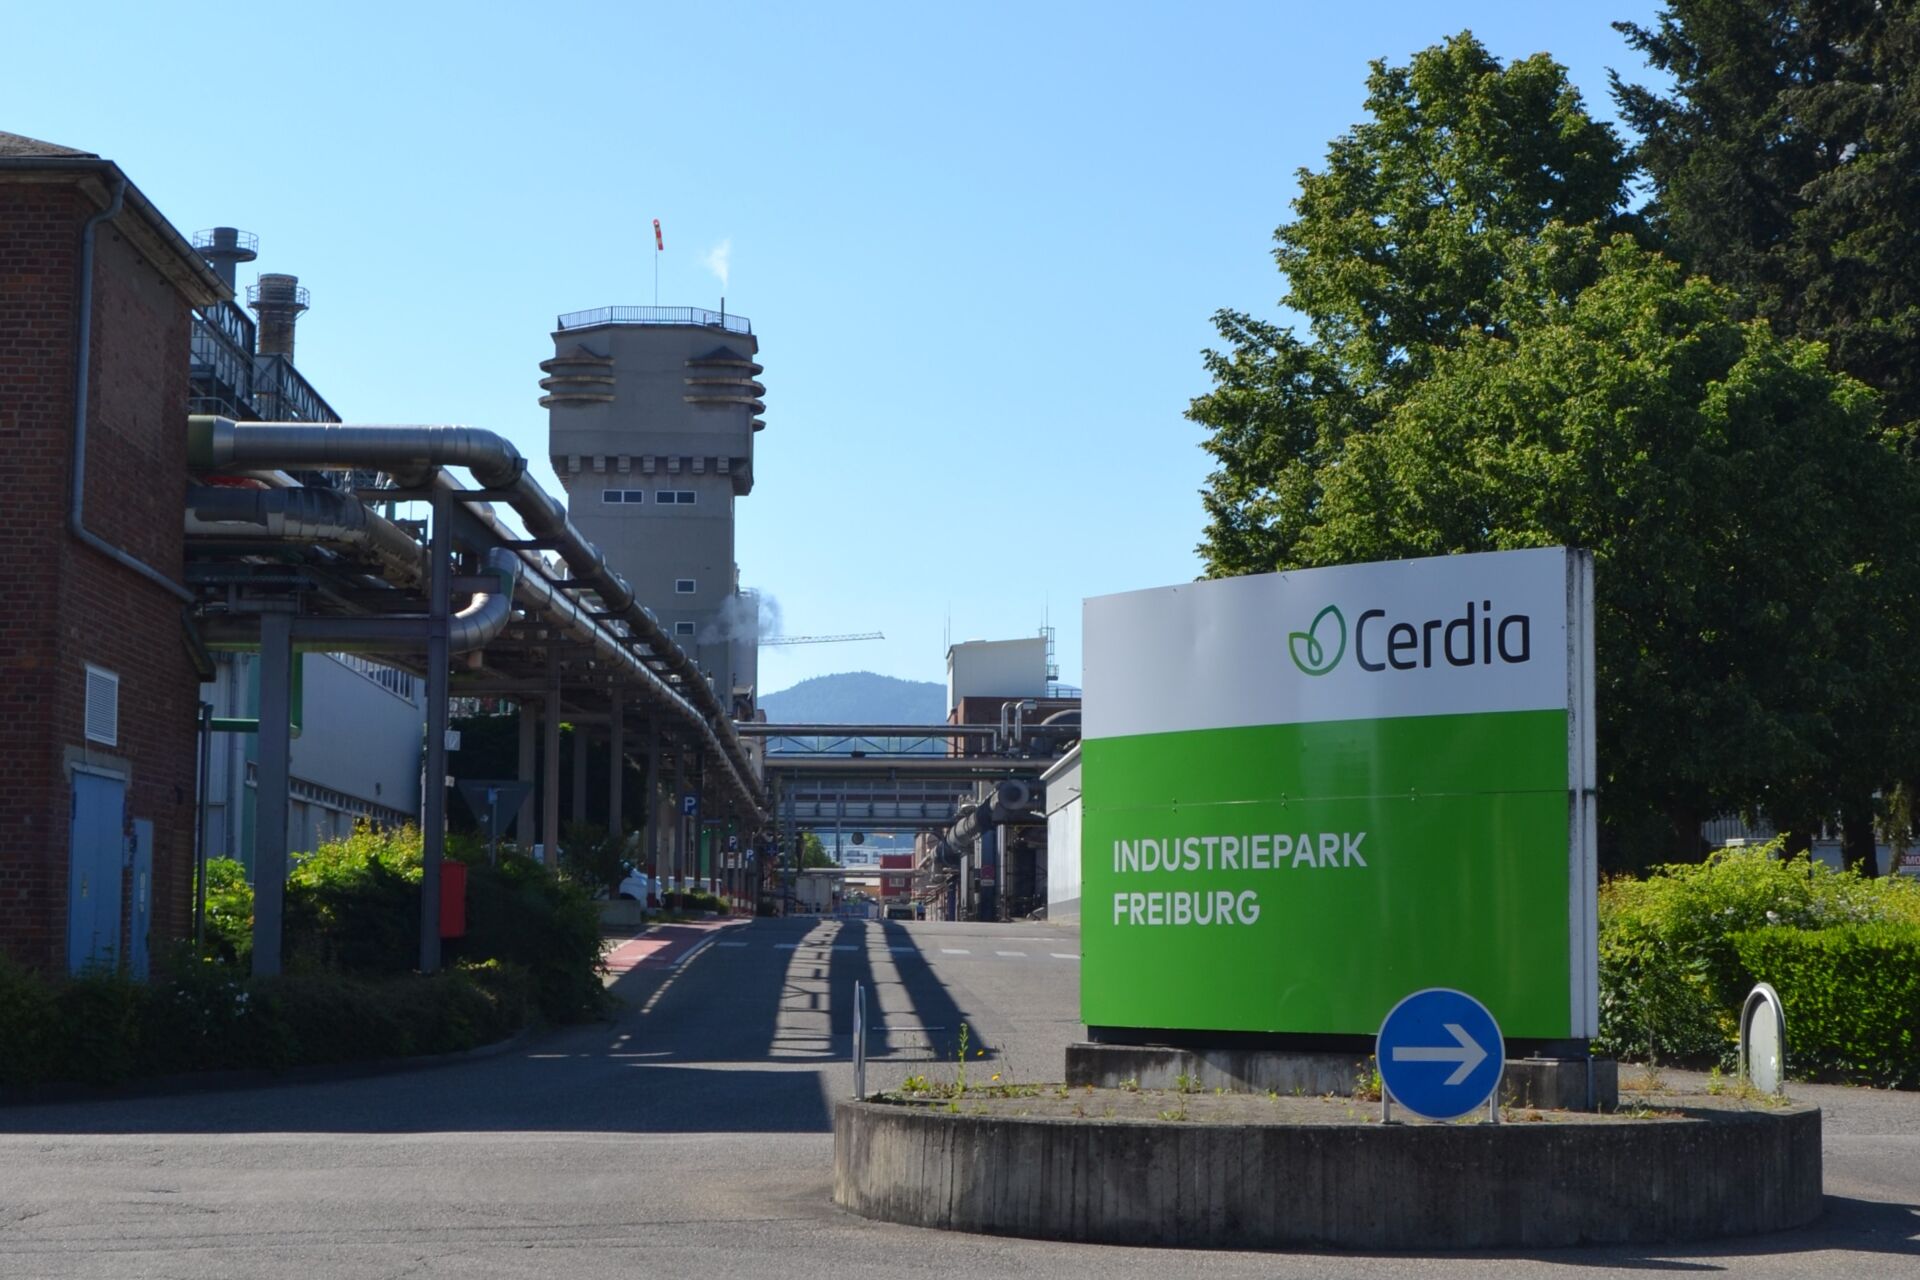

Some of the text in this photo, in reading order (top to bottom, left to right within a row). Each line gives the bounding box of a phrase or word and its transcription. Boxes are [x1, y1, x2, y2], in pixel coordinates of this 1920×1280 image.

[1355, 600, 1531, 672] Cerdia
[684, 796, 696, 812] P
[729, 835, 737, 847] P
[1113, 832, 1368, 873] INDUSTRIEPARK
[746, 849, 754, 860] P
[1113, 890, 1260, 926] FREIBURG
